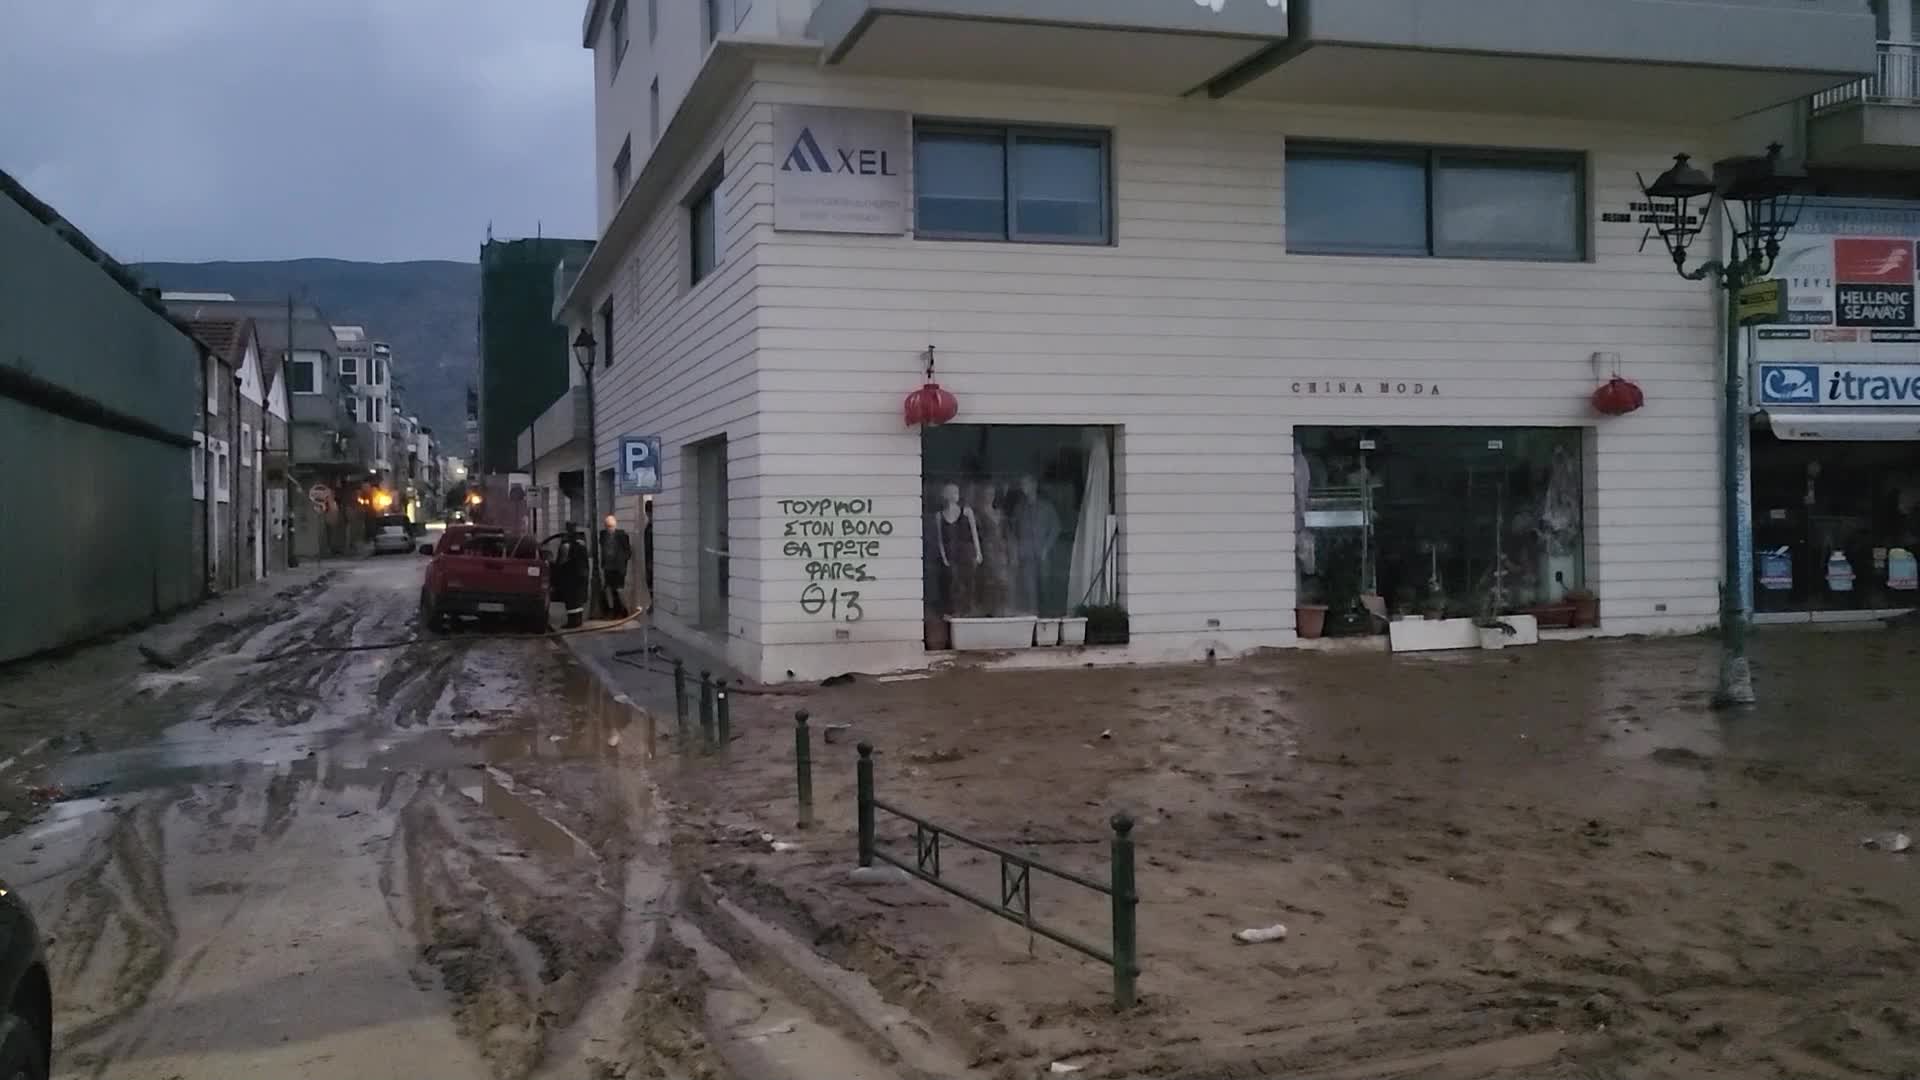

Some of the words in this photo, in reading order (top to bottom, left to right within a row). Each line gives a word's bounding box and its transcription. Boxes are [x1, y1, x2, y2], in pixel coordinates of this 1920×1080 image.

[780, 127, 897, 176] AXEL
[1840, 291, 1910, 304] HELLENIC
[1844, 306, 1906, 319] SEAWAYS
[1291, 381, 1362, 394] CHINA
[1380, 382, 1440, 395] MODA
[625, 442, 649, 473] P
[783, 519, 834, 537] ΣΤΟΝ
[841, 519, 893, 536] ΒΟΛΟ
[783, 541, 812, 558] ΘΑ
